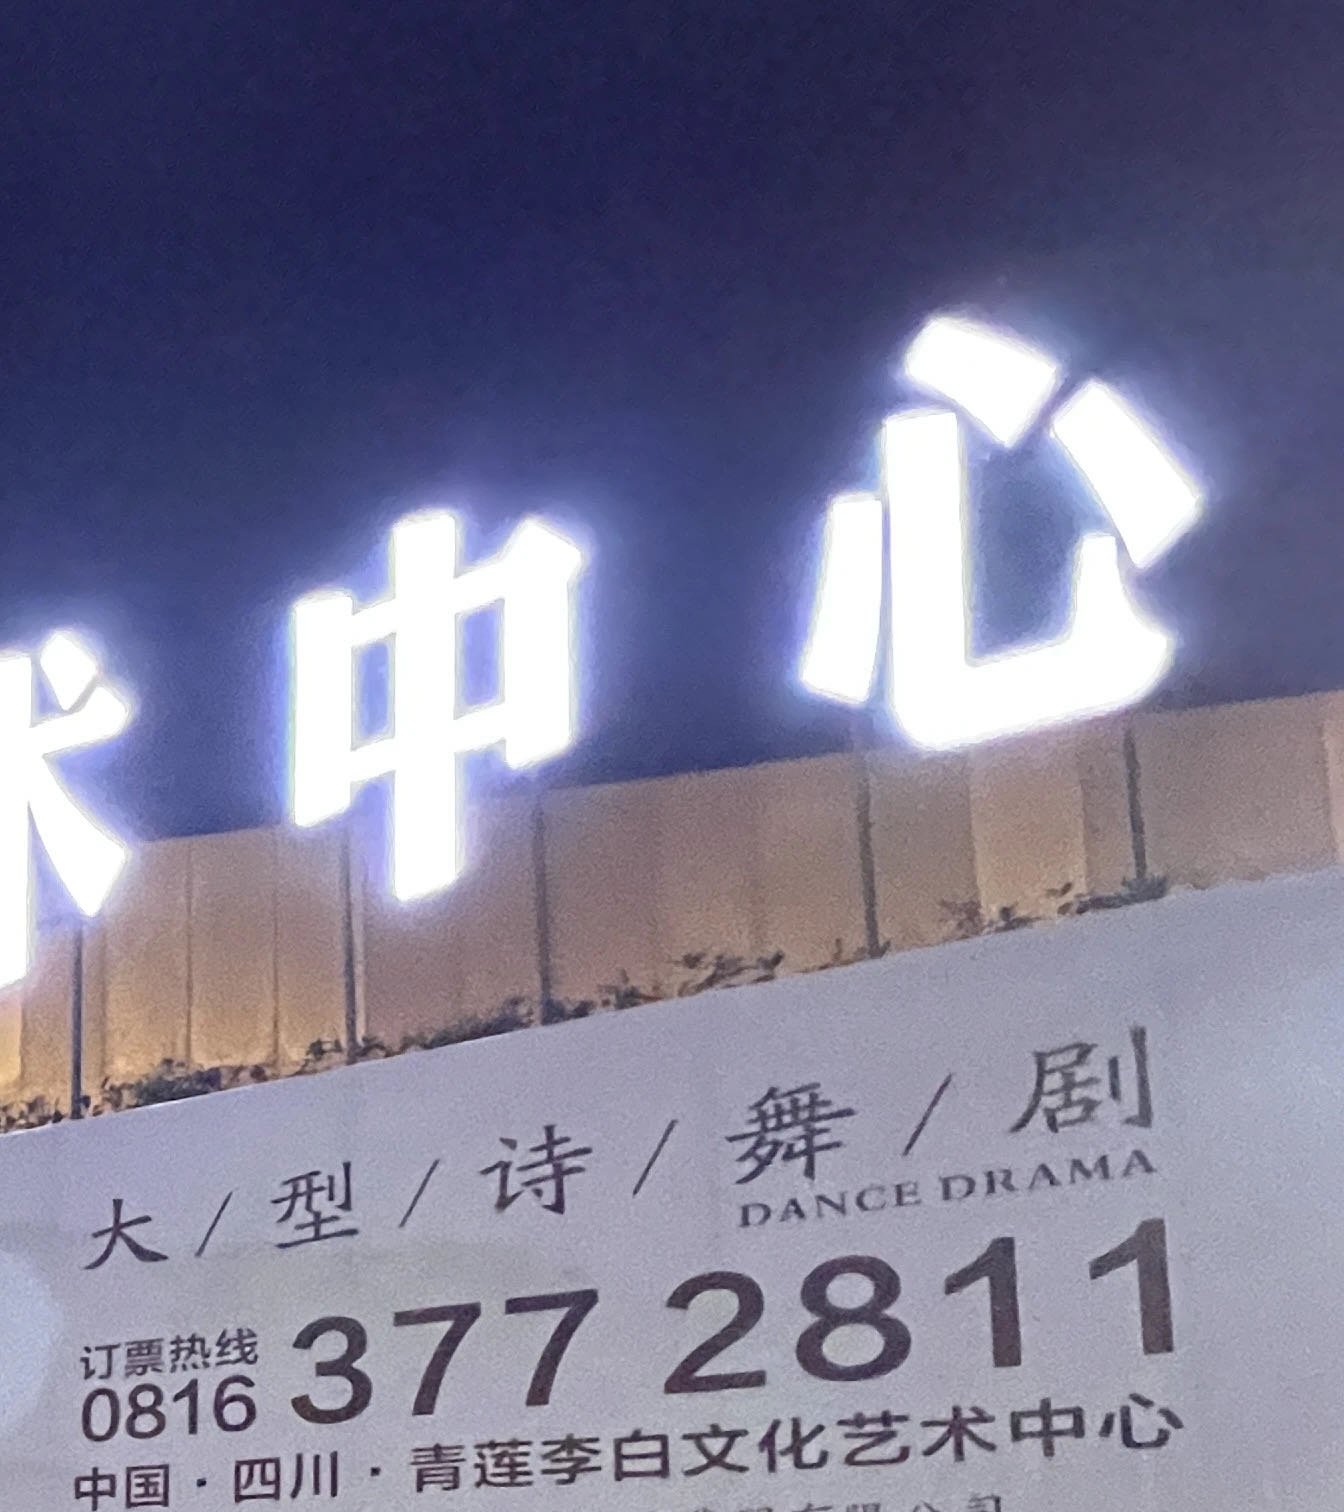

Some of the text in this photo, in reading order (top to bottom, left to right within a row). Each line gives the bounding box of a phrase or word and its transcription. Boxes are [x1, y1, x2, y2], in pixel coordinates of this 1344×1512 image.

[738, 1148, 1158, 1228] DANCE DRAMA
[79, 1327, 260, 1382] 订票热线
[80, 1217, 1175, 1443] 0816 377 2811
